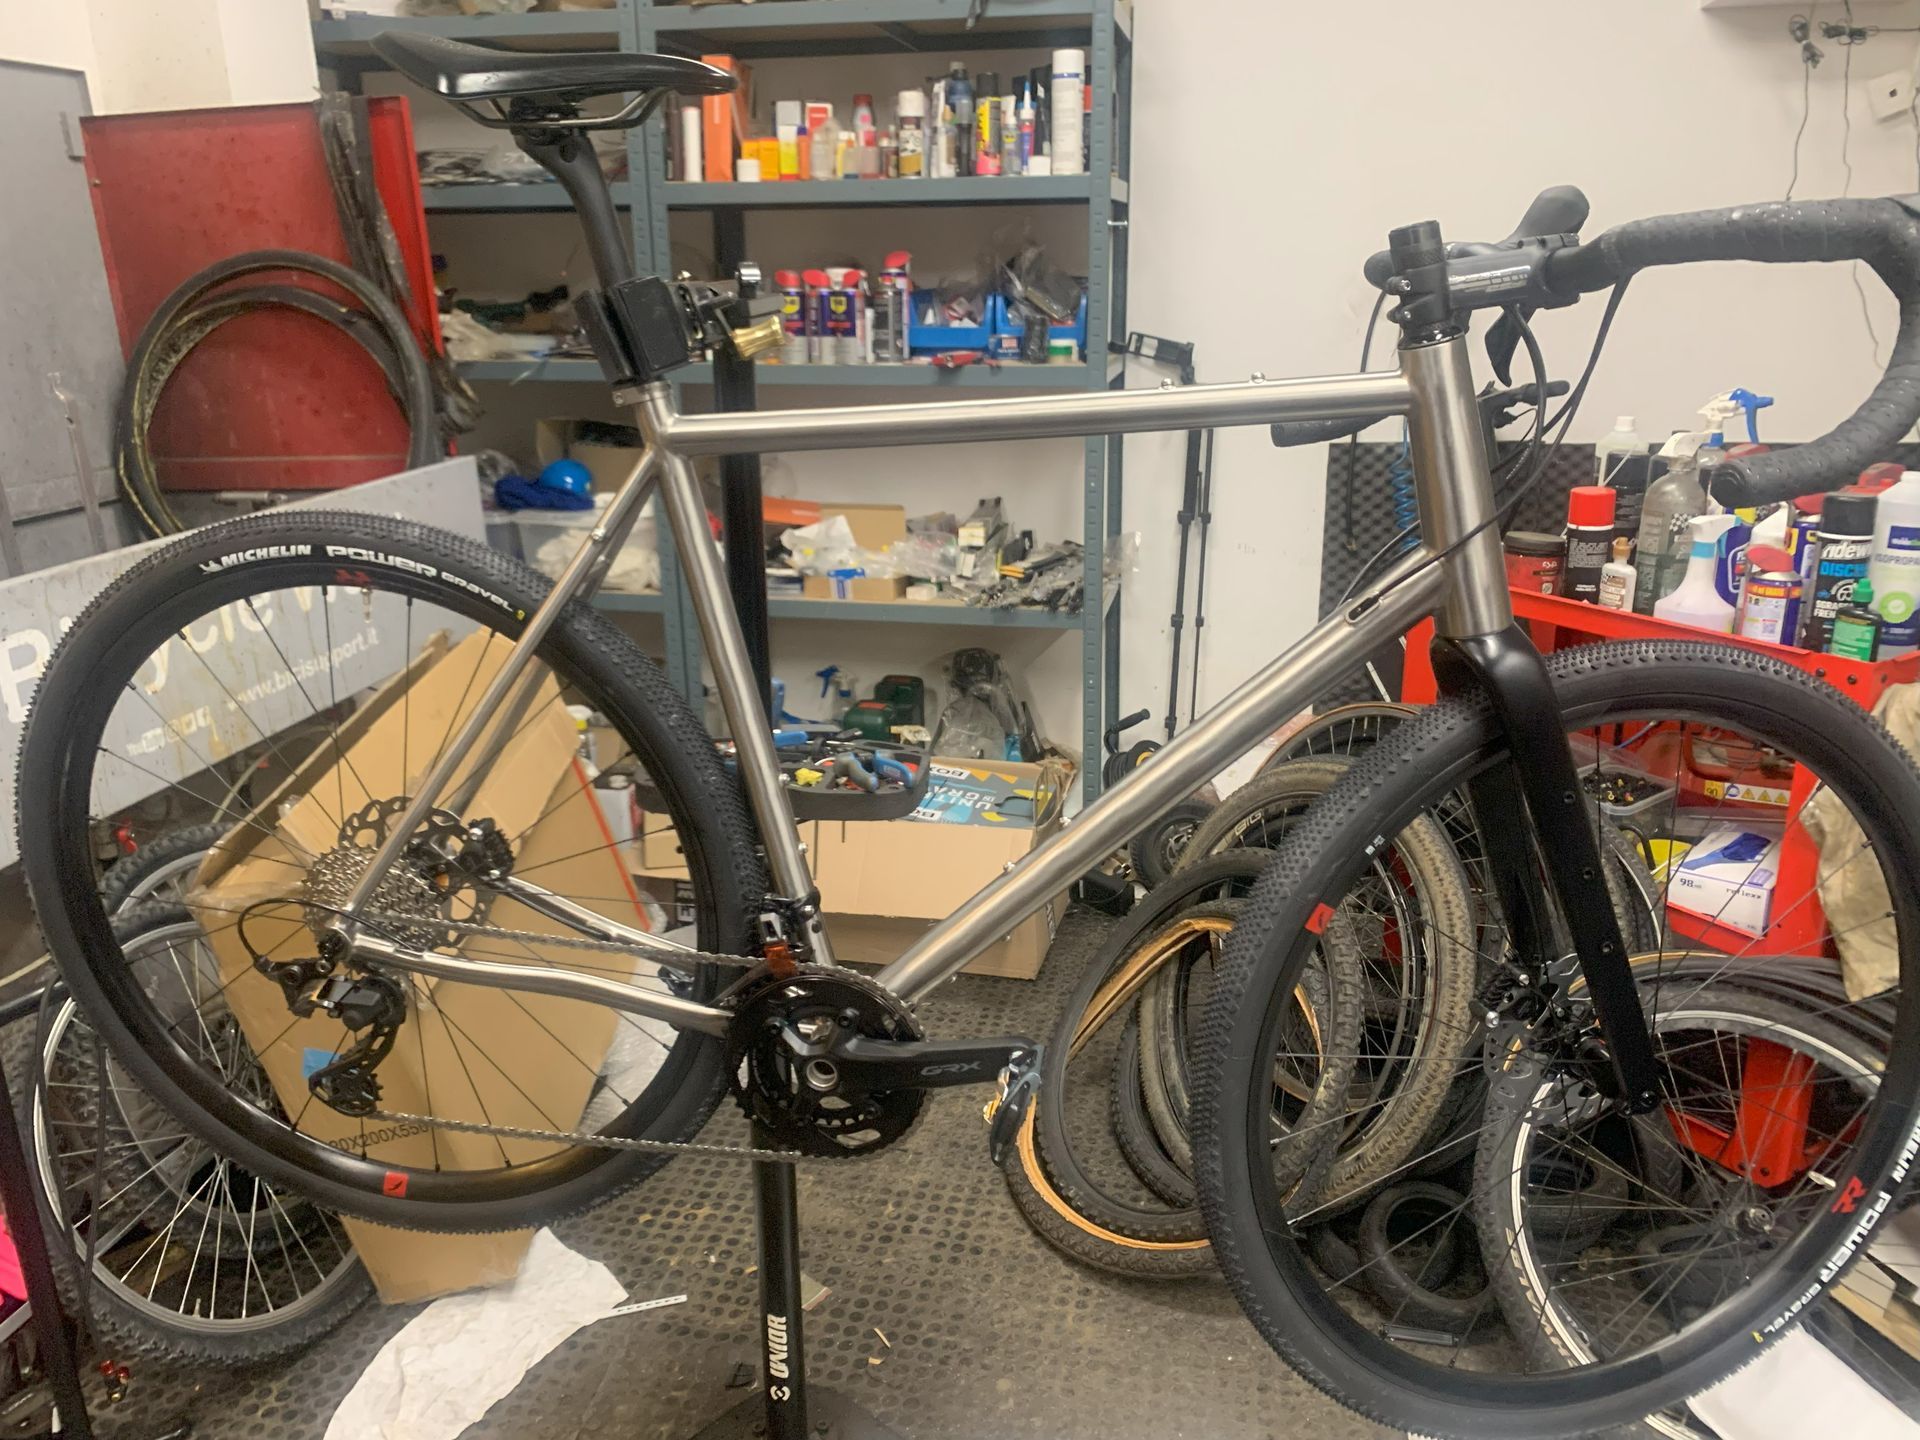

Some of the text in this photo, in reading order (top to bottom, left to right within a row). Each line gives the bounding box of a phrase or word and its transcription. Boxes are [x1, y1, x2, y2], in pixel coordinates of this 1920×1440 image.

[221, 544, 312, 568] MICHELIN
[325, 545, 437, 578] POWER
[1680, 878, 1694, 888] 98
[921, 1061, 982, 1076] GRX
[1820, 1190, 1892, 1284] POWER
[767, 1314, 789, 1378] UNIOR
